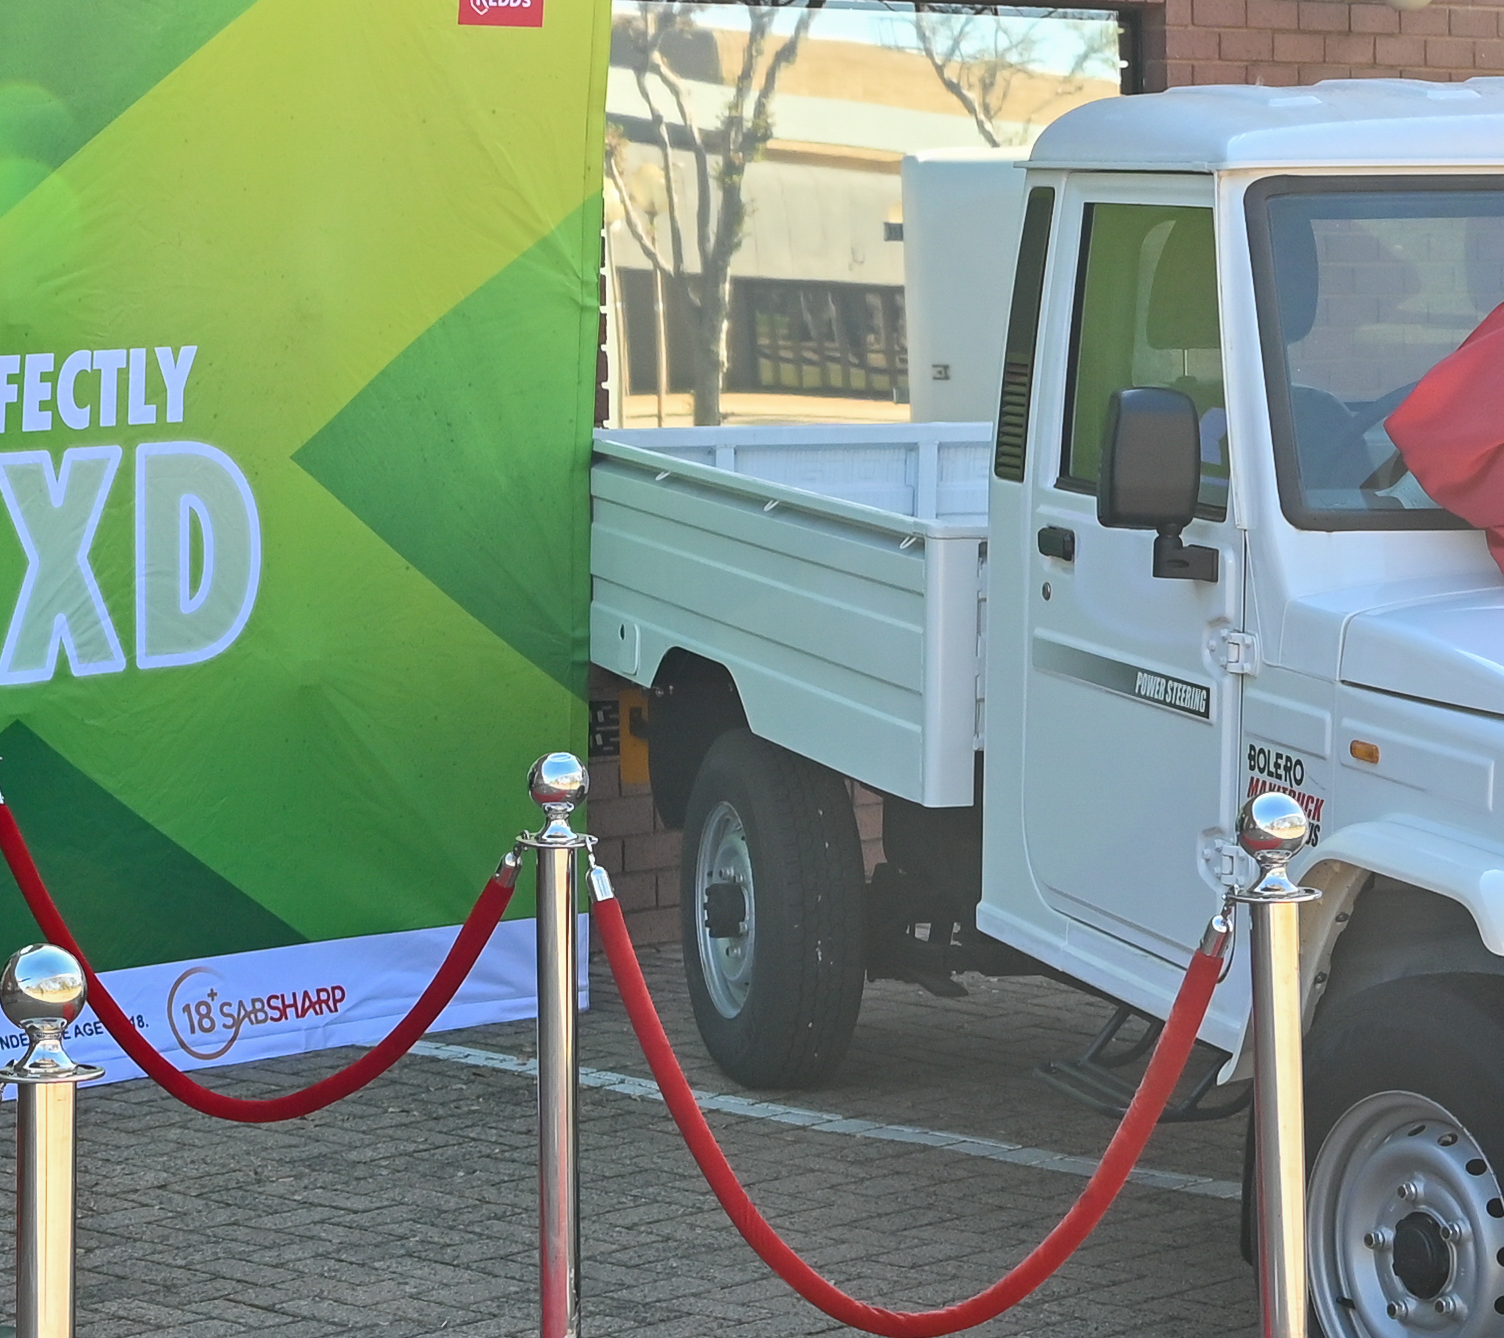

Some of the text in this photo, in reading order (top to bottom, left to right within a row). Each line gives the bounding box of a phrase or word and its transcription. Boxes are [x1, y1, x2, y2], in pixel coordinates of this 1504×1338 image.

[1135, 671, 1207, 713] POWER STEERING
[1248, 744, 1304, 788] BOLERO
[74, 1021, 104, 1039] AGE
